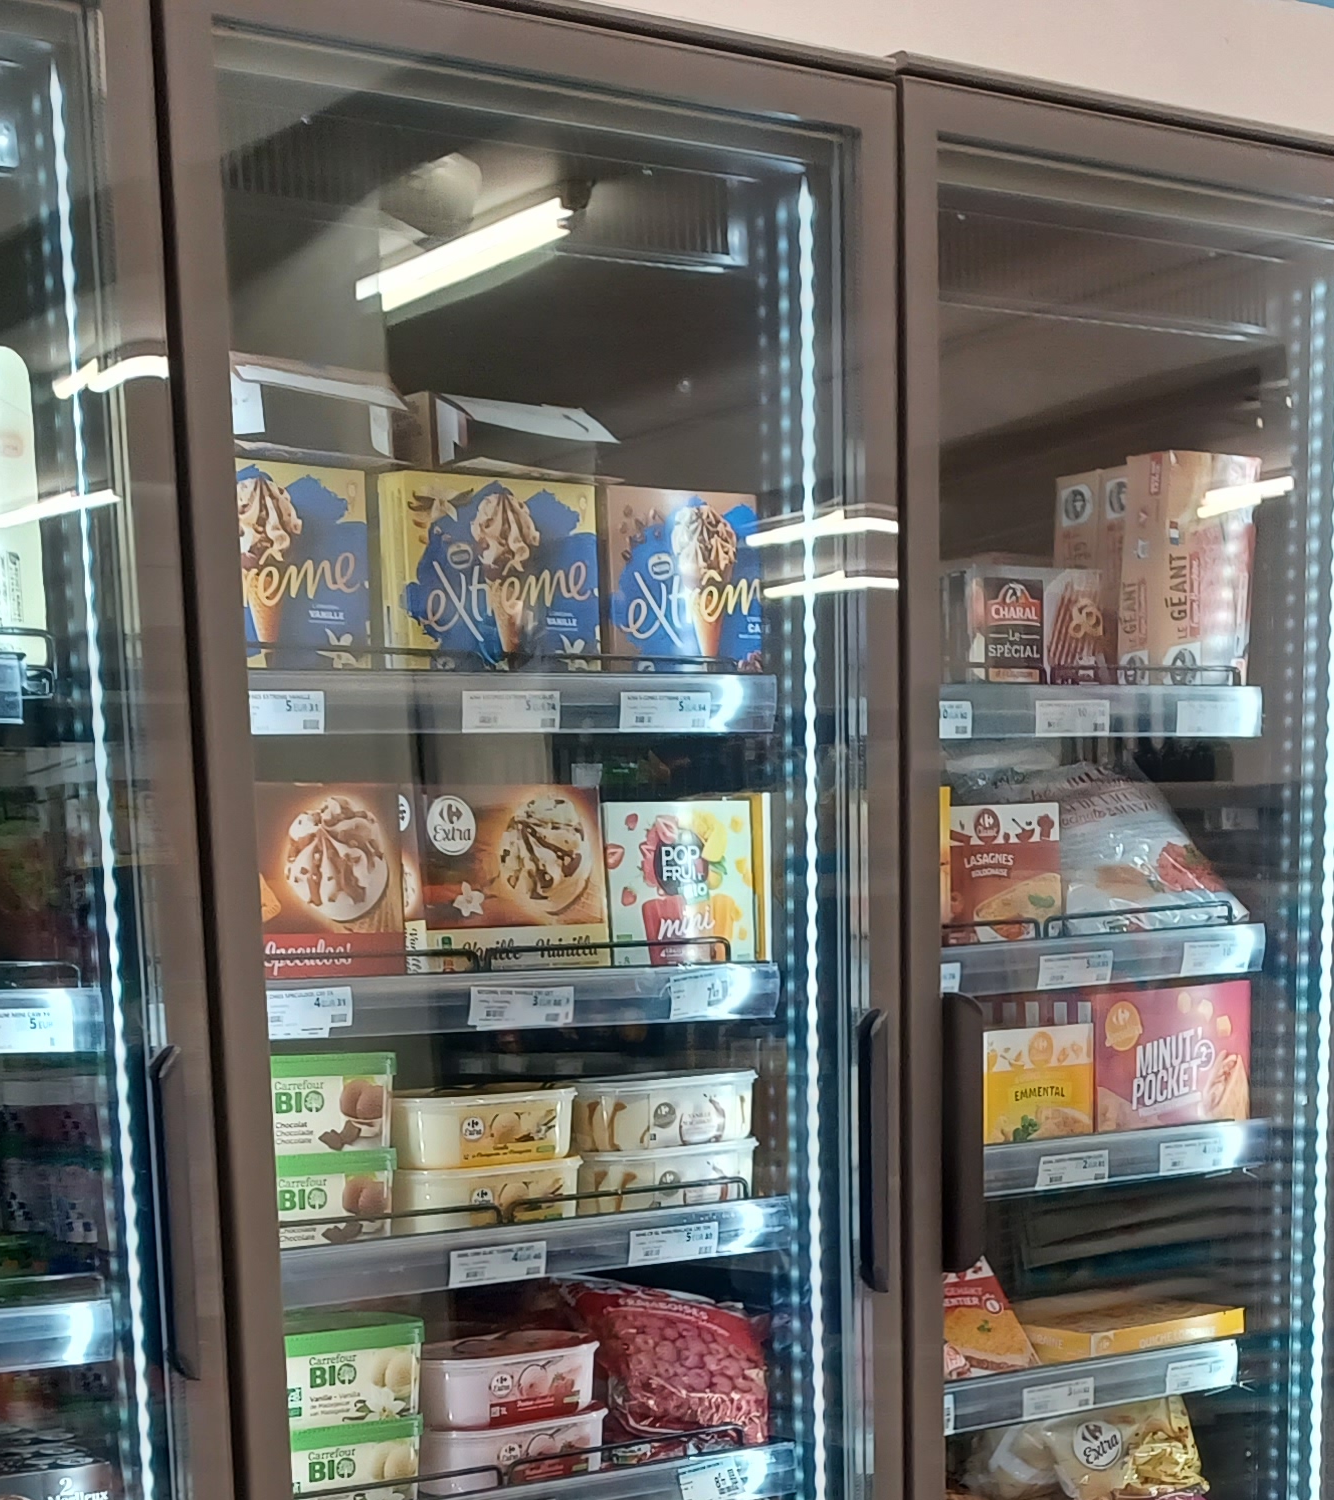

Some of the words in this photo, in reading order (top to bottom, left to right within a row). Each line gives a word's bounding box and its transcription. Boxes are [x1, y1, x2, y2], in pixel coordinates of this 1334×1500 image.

[1164, 552, 1189, 623] GÉANT
[309, 608, 345, 621] VANILLE
[991, 602, 1039, 621] CHARAL
[546, 616, 578, 628] VANILLE
[988, 642, 1041, 659] SPÉCIAL
[285, 699, 292, 711] 5
[293, 703, 308, 711] EUR
[432, 824, 473, 844] Extra
[661, 845, 701, 865] POP
[964, 853, 1015, 869] LASAGNES
[658, 908, 716, 941] mini
[29, 1018, 37, 1030] 5
[274, 1080, 324, 1093] Carrefour
[1014, 1085, 1066, 1102] EMMENTAL
[1132, 1059, 1201, 1112] POCKET
[275, 1090, 325, 1114] BIO
[275, 1121, 308, 1130] Chocolat
[278, 1176, 328, 1189] Carrefour
[278, 1187, 328, 1211] BIO
[309, 1353, 357, 1366] Carrefour
[309, 1363, 357, 1388] BIO
[308, 1448, 356, 1461] Carrefour
[1082, 1434, 1121, 1466] Extra
[308, 1457, 356, 1483] BIO
[58, 1477, 74, 1496] 2
